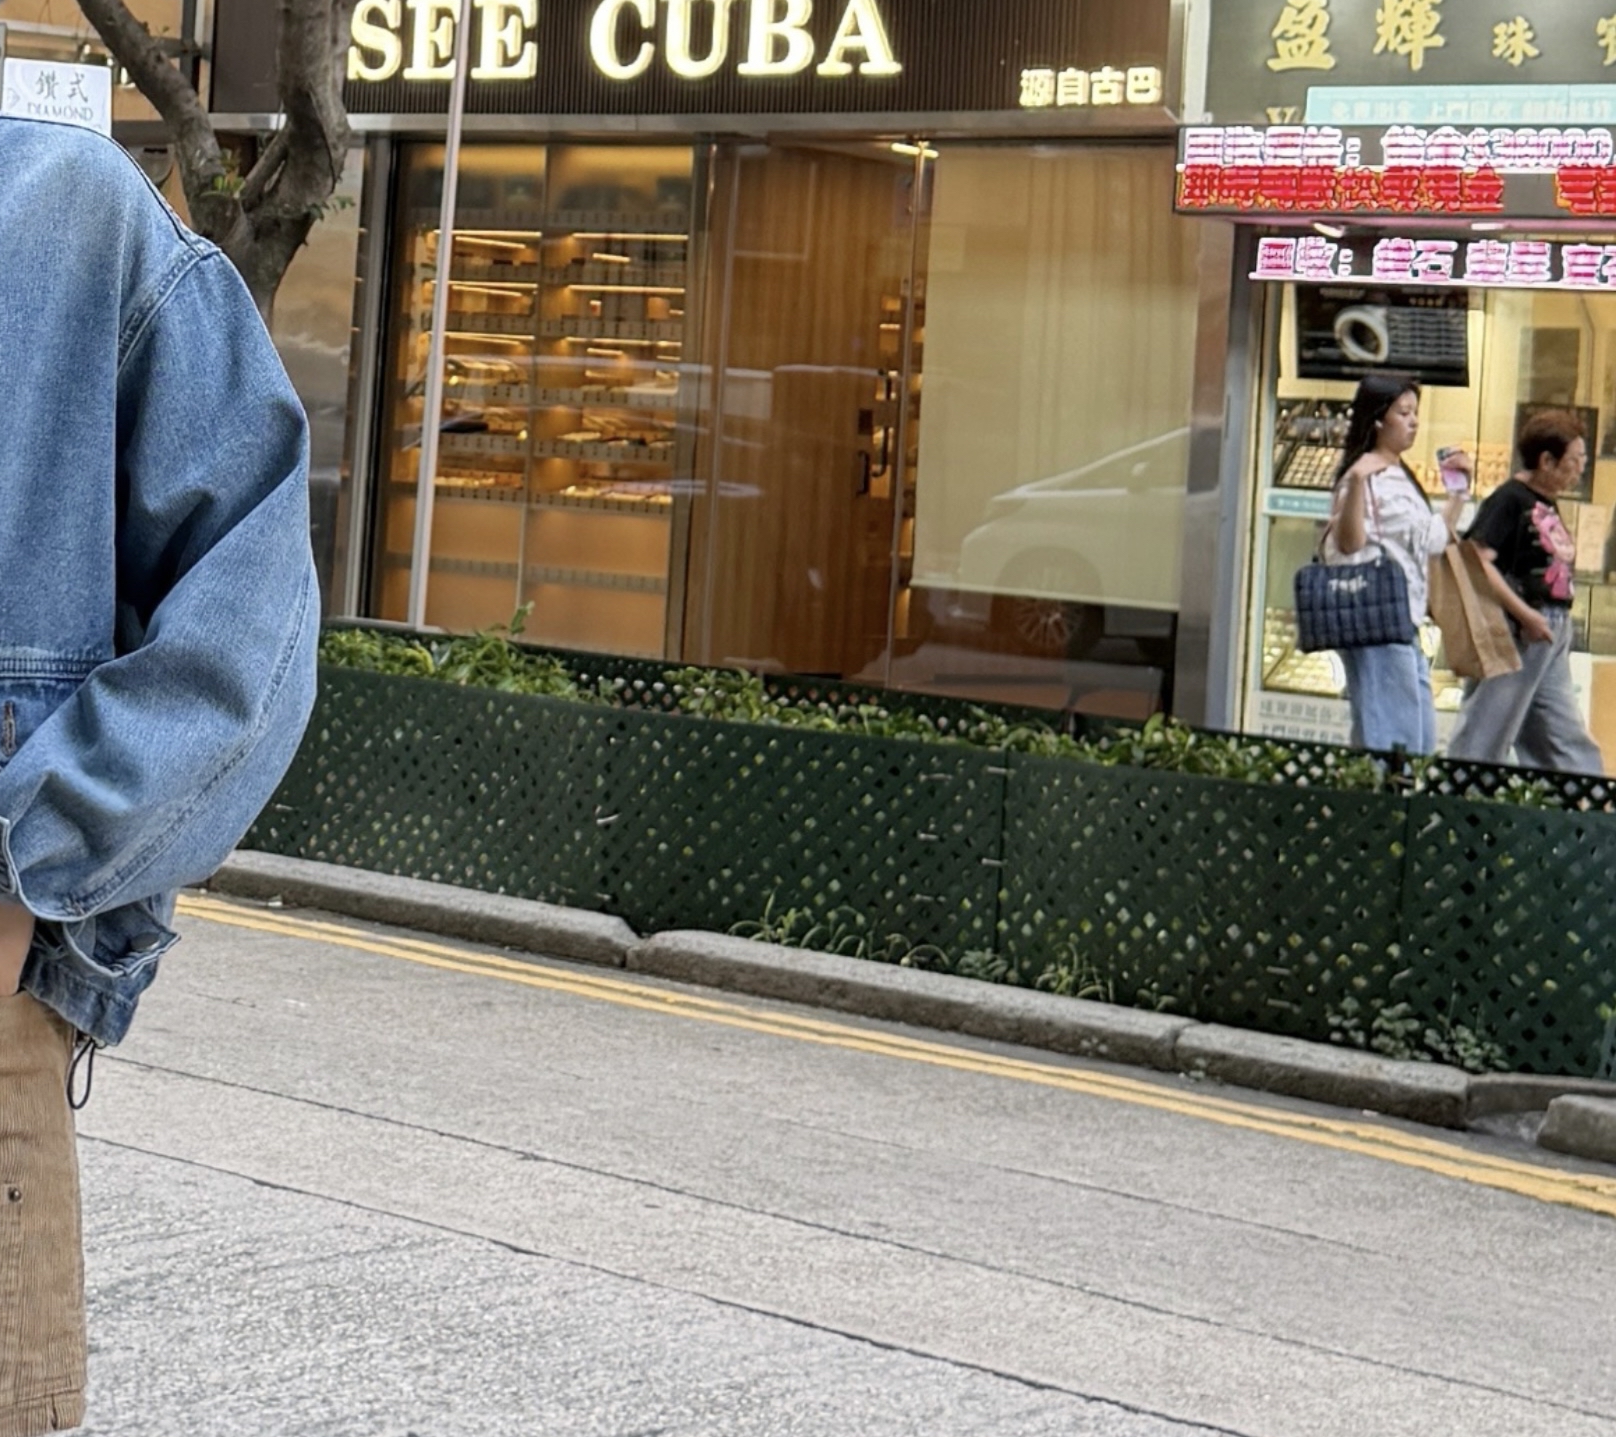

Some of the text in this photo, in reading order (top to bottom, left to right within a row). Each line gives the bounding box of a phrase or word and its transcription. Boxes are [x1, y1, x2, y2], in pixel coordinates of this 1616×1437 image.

[1019, 66, 1162, 107] 源自古巴
[27, 101, 95, 123] DIAMOND
